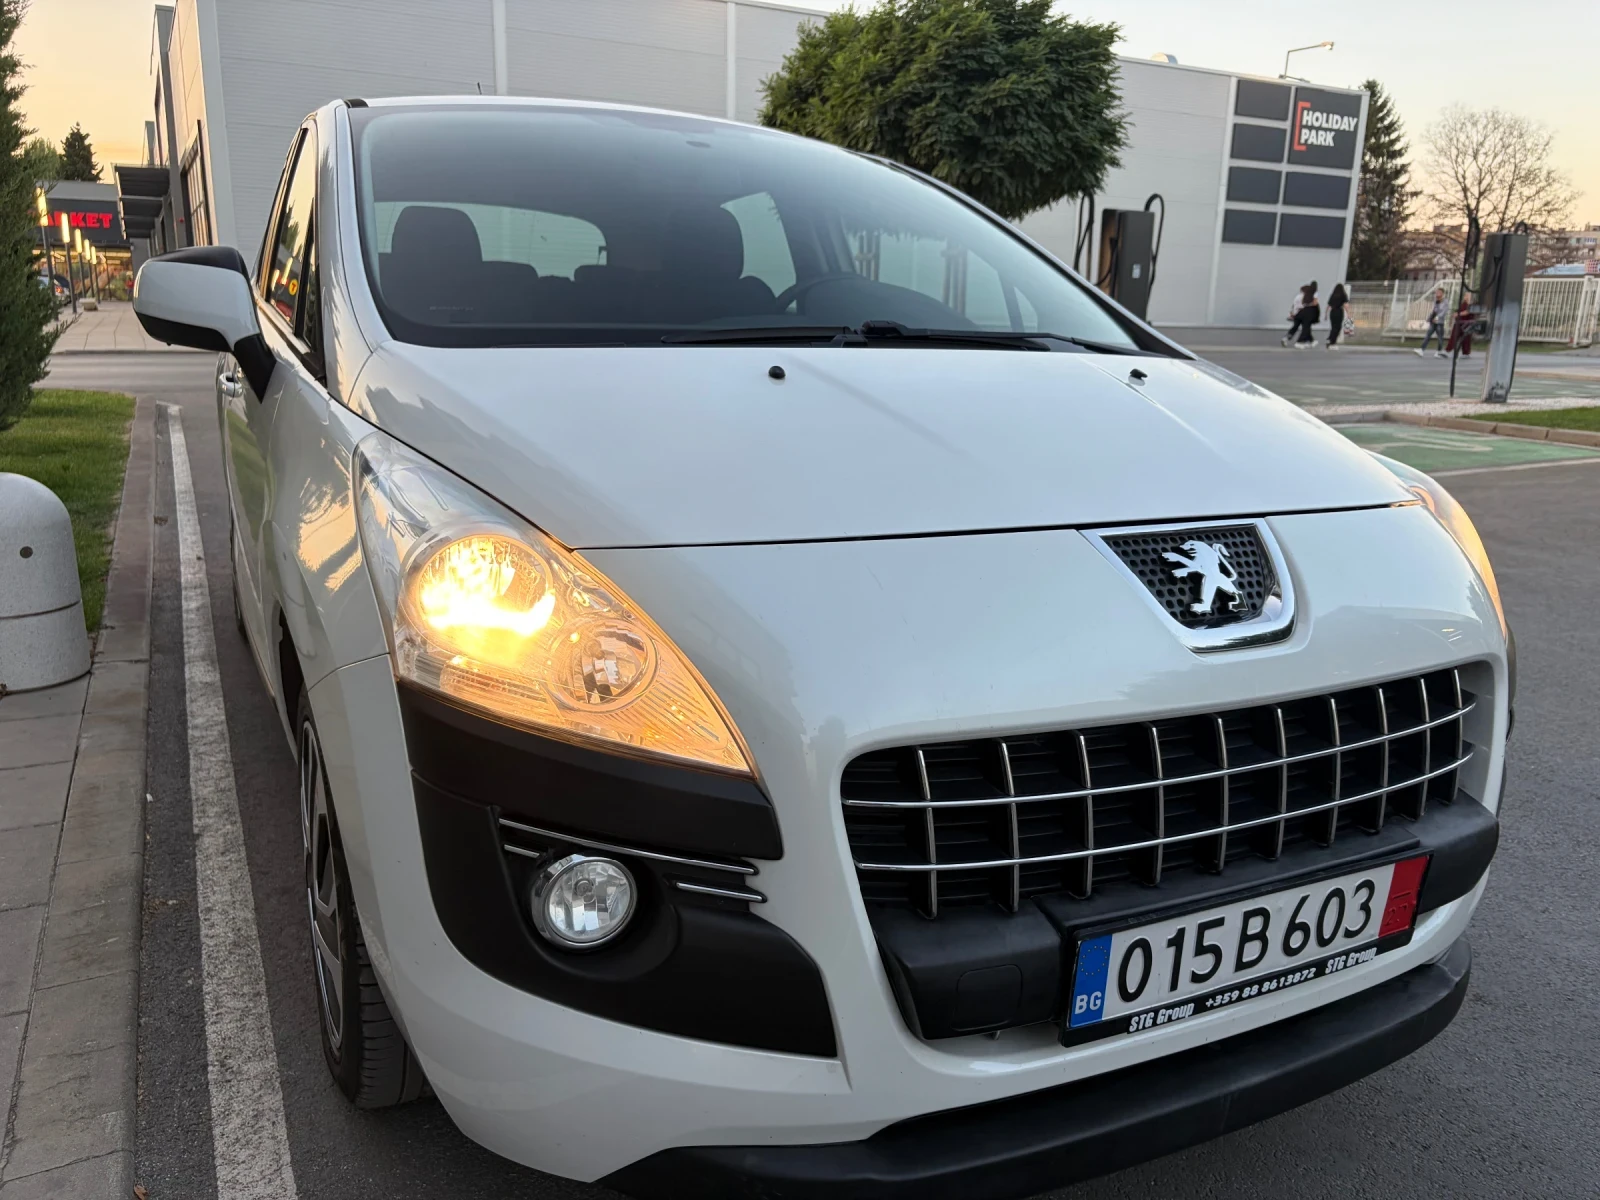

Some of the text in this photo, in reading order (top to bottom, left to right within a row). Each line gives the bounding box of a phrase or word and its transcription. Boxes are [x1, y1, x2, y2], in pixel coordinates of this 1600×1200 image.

[1302, 110, 1358, 131] HOLIDAY
[1300, 129, 1336, 146] PARK
[1128, 946, 1378, 1033] STG Group +359 88 8613872 STG Group
[1074, 990, 1102, 1015] BG
